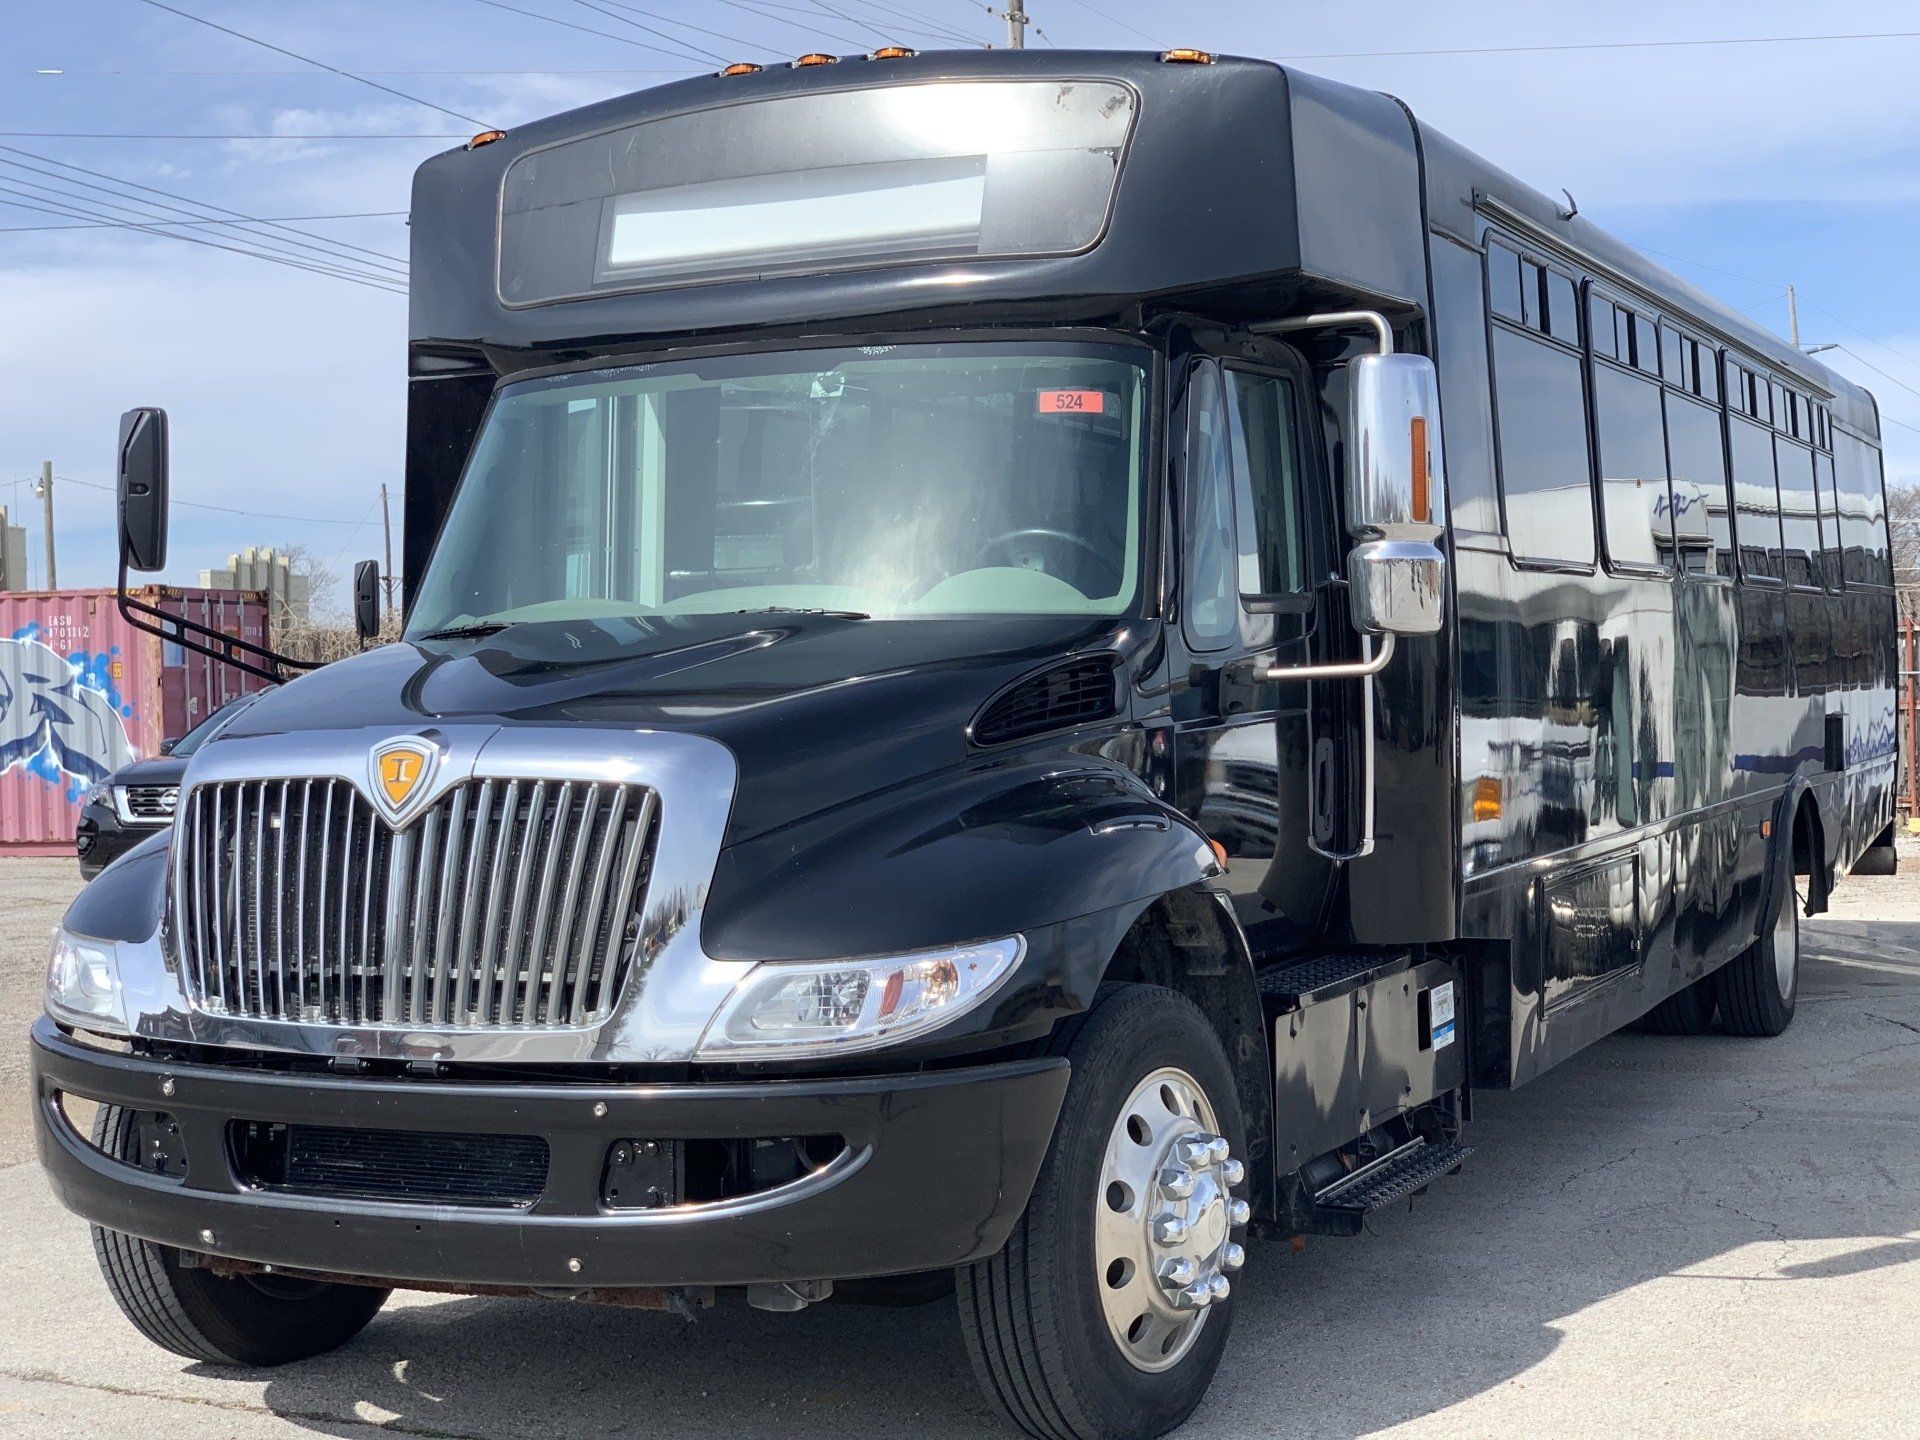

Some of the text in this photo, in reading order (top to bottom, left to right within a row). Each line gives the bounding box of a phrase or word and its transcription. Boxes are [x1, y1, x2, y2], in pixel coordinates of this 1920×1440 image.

[1056, 394, 1083, 409] 524
[48, 615, 72, 627] EASU
[388, 757, 414, 783] I
